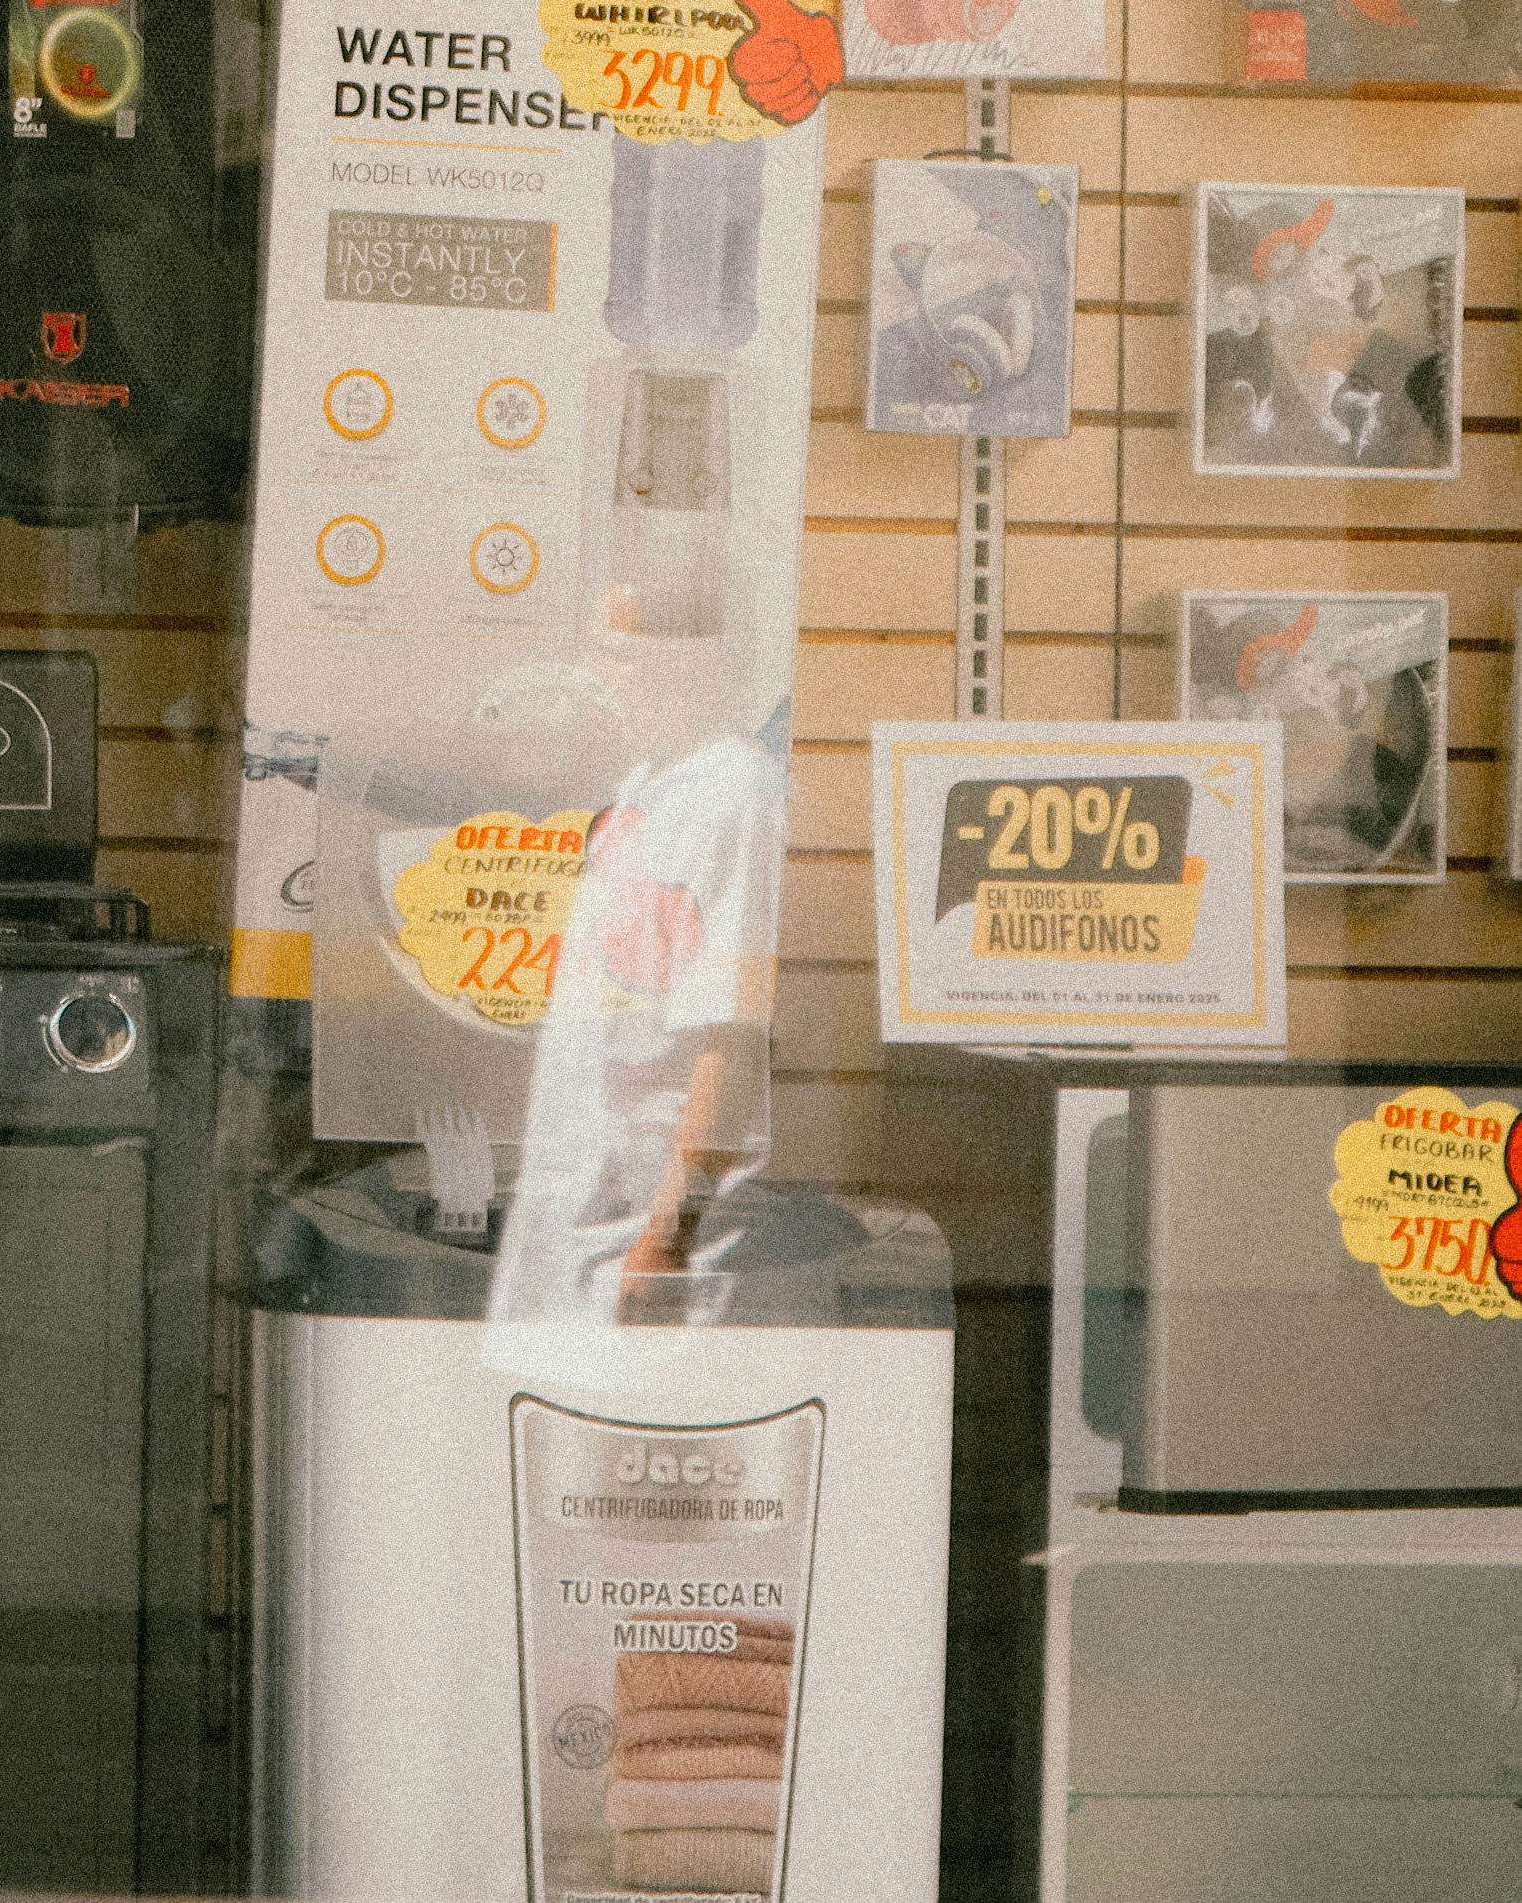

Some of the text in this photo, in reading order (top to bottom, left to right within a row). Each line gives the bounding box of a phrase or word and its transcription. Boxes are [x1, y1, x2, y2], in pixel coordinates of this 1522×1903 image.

[335, 25, 512, 72] WATER
[597, 48, 727, 117] 3299
[331, 161, 546, 193] MODEL WK5012Q
[338, 220, 391, 236] COLD
[415, 223, 455, 239] HOT
[460, 225, 527, 243] WATER
[337, 240, 526, 274] INSTANTLY
[338, 269, 413, 297] 10°C
[450, 274, 527, 304] 85°C
[455, 825, 585, 854] OFERTA
[957, 785, 1161, 872] -20%
[465, 887, 551, 913] DACE
[987, 888, 1104, 911] EN TODOS LOS
[987, 914, 1161, 953] AUDIFONOS
[1384, 1104, 1503, 1144] OFERTA
[1380, 1132, 1495, 1164] FRIGOBAR
[615, 1442, 746, 1486] dace
[560, 1496, 784, 1521] CENTRIFUGADORA DE ROPA
[559, 1580, 783, 1608] TU ROPA SECA EN
[613, 1623, 738, 1653] MINUTOS
